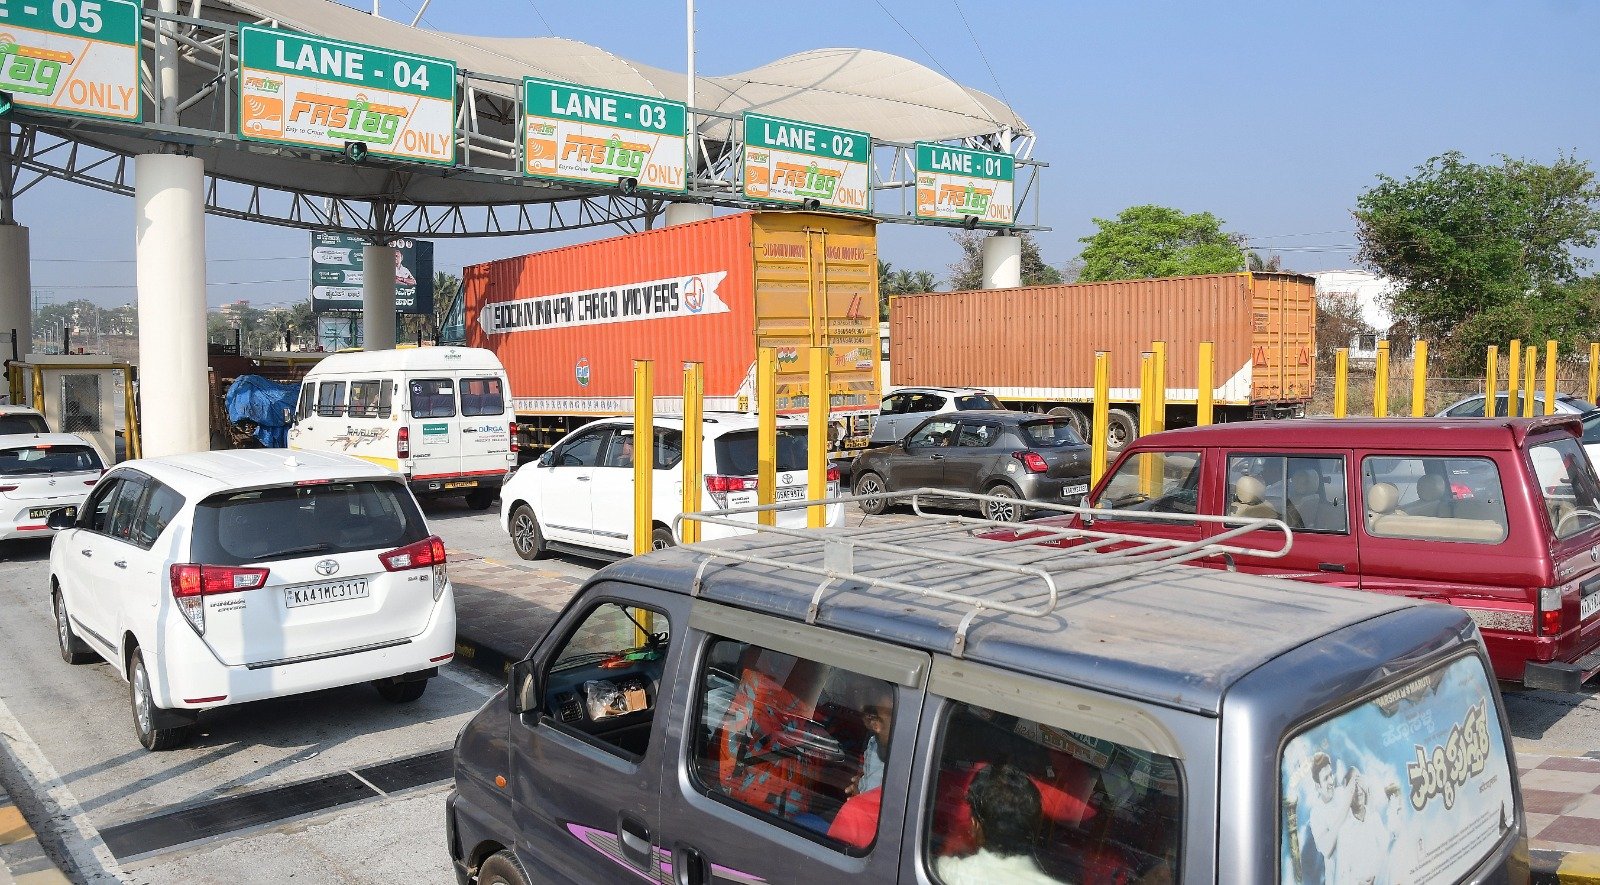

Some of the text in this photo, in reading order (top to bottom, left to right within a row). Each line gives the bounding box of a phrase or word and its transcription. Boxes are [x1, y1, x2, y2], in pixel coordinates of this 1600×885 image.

[52, 0, 103, 33] 05
[275, 39, 364, 81] LANE
[393, 61, 430, 91] 04
[69, 79, 135, 111] ONLY
[551, 89, 618, 123] LANE
[639, 104, 667, 130] 03
[289, 91, 409, 145] FASTag
[403, 129, 450, 156] ONLY
[561, 133, 651, 177] FASTag
[764, 122, 816, 152] LANE
[832, 135, 854, 158] 02
[647, 163, 683, 185] ONLY
[931, 149, 972, 173] LANE
[985, 157, 1001, 177] 01
[772, 161, 842, 199] FASTag
[838, 186, 866, 206] ONLY
[990, 203, 1012, 219] ONLY
[578, 290, 618, 321] CARGO
[622, 282, 679, 317] MOVERS
[478, 425, 504, 433] DURGA
[293, 581, 367, 603] KA41MC3117
